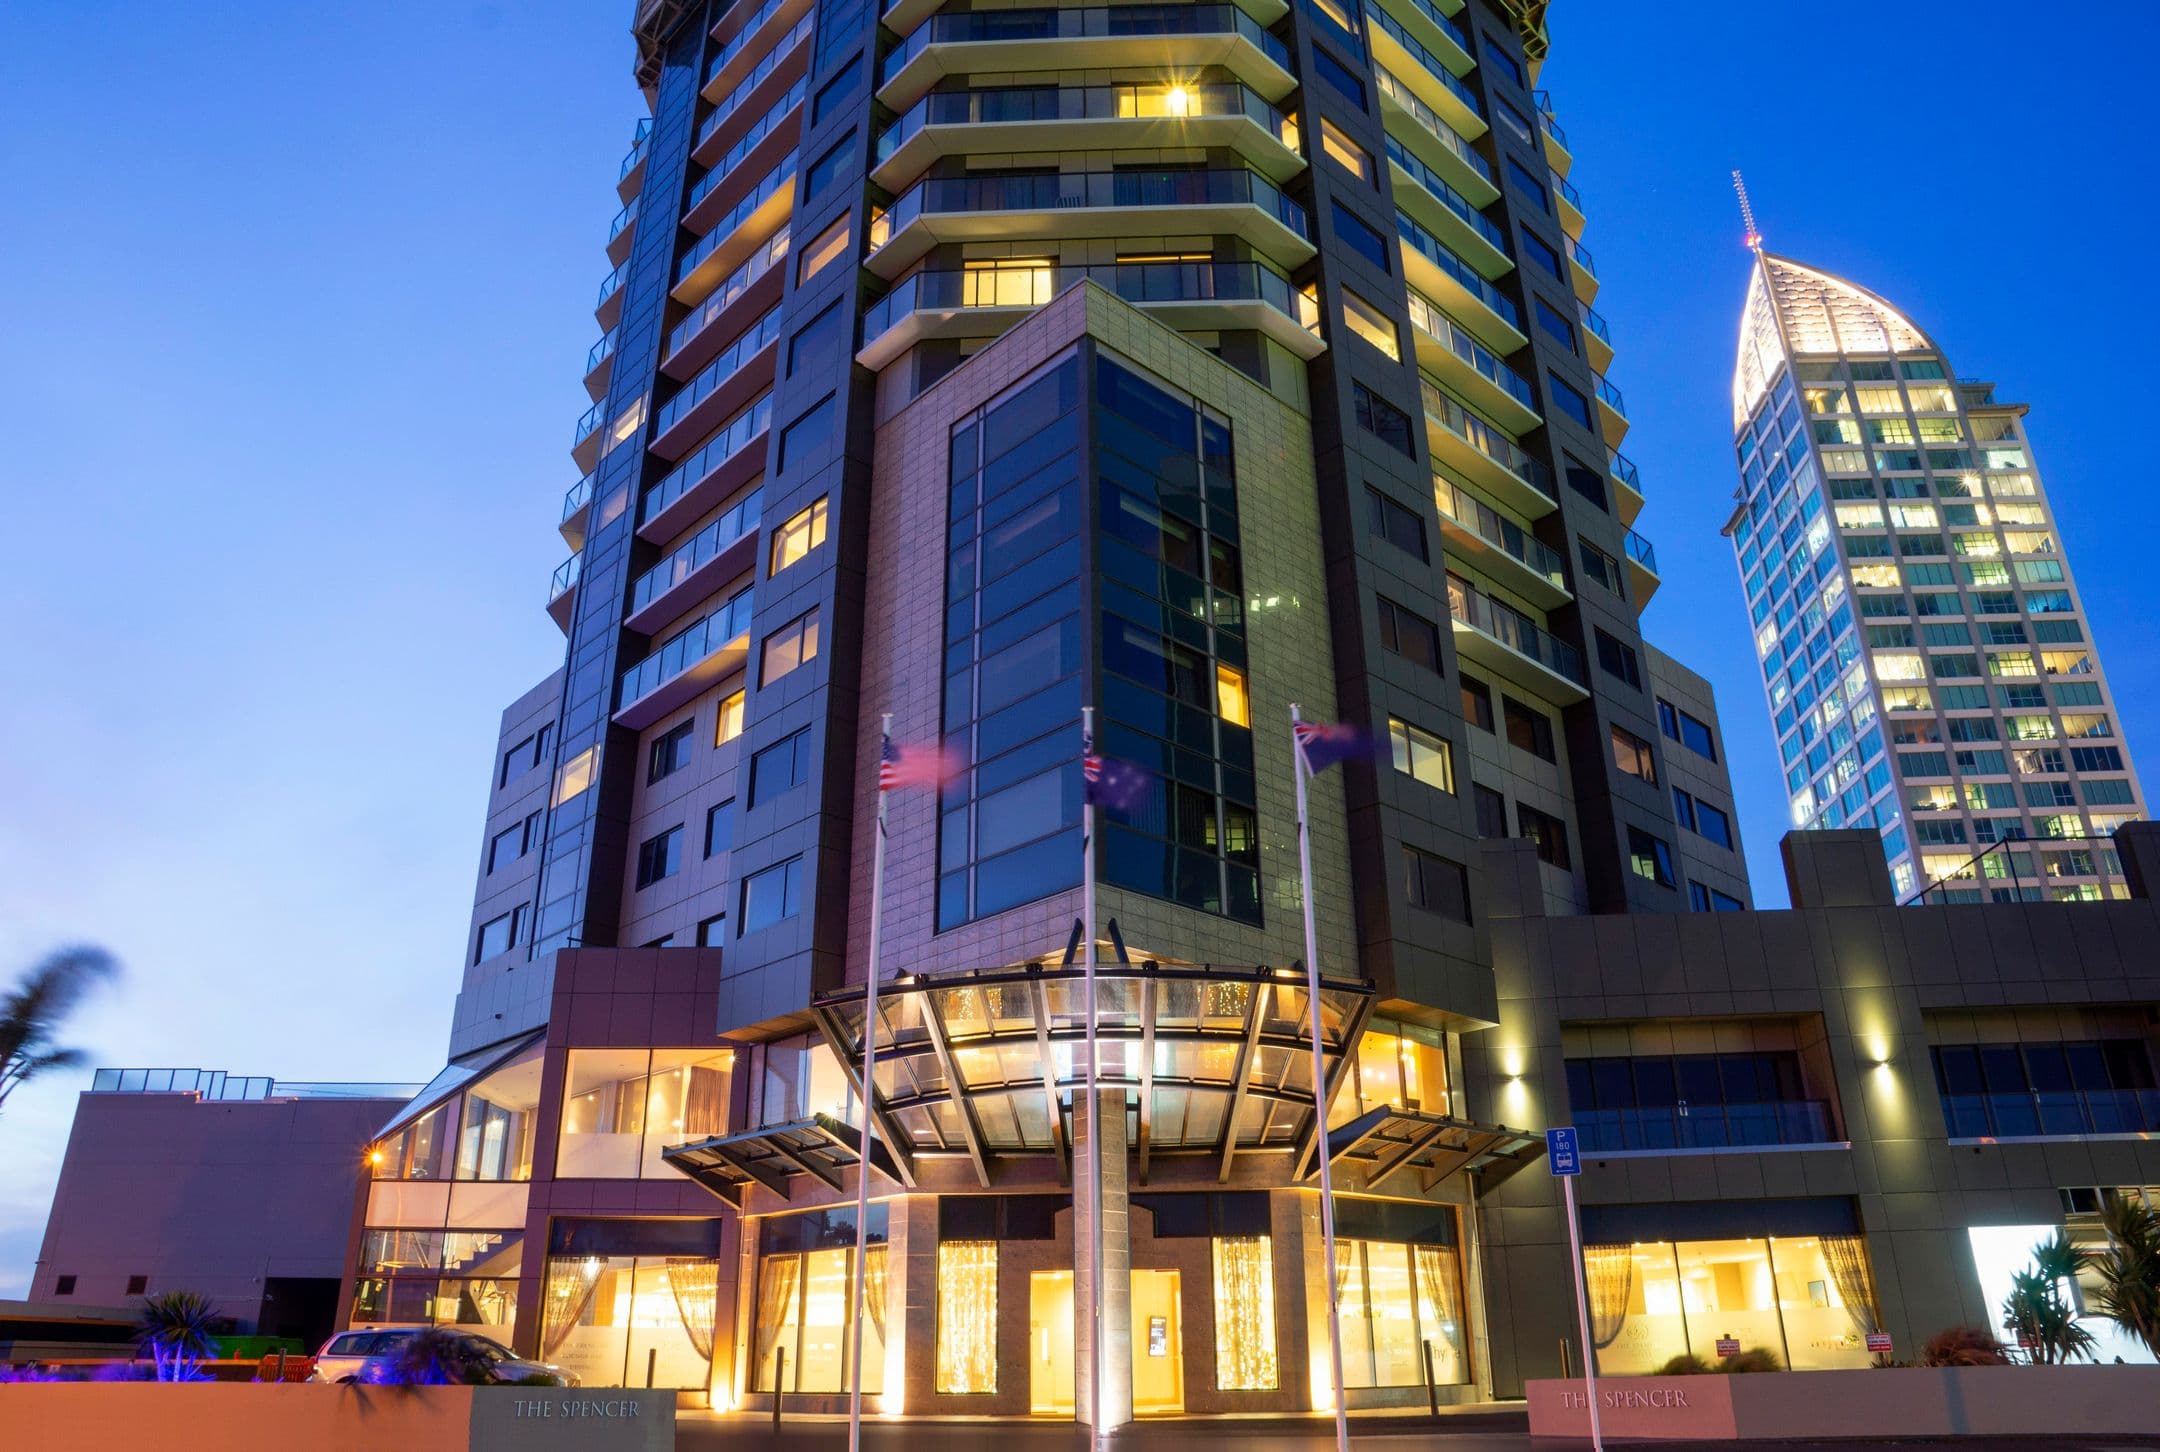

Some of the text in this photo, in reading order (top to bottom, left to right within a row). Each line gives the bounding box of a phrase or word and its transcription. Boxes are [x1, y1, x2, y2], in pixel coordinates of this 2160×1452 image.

[1556, 1131, 1565, 1141] P
[1560, 1390, 1689, 1408] TH SPENCER
[514, 1400, 640, 1417] THE SPENCER
